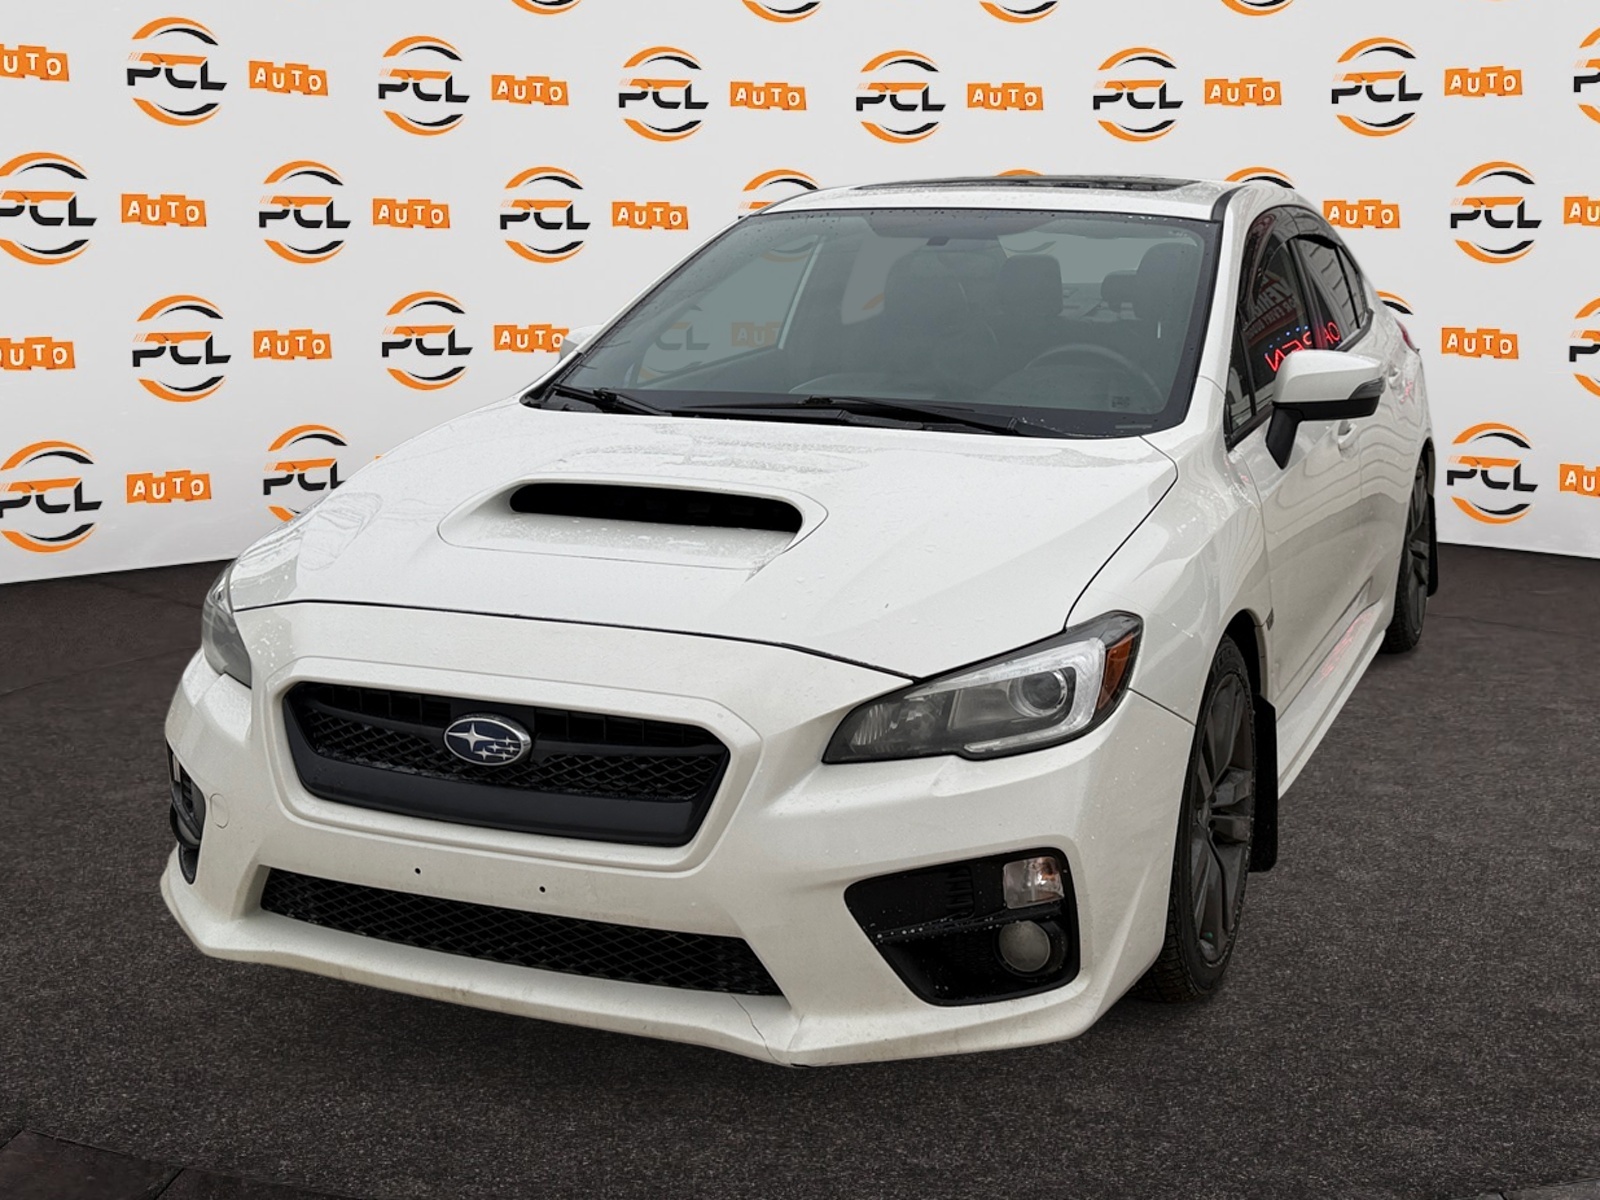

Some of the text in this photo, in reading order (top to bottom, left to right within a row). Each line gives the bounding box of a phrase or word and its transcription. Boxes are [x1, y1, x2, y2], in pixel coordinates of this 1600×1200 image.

[3, 52, 62, 76] UTO
[127, 53, 322, 92] PCL AUTO
[379, 69, 563, 103] PCL AUTO
[619, 79, 801, 110] PCL AUTO
[856, 83, 1038, 112] PCL AUTO
[1093, 80, 1276, 110] PCL AUTO
[1332, 71, 1517, 105] PCL AUTO
[127, 200, 201, 223] AUTO
[259, 196, 444, 229] PCL AUTO
[500, 200, 683, 230] PCL AUTO
[1327, 205, 1394, 225] AUTO
[1451, 197, 1600, 229] PCL AU
[0, 343, 68, 367] UTO
[133, 332, 326, 368] PCL AUTO
[382, 325, 566, 358] PCL AUTO
[1446, 333, 1513, 355] AUTO
[1447, 456, 1600, 493] PCL AU
[0, 477, 206, 519] PCL AUTO
